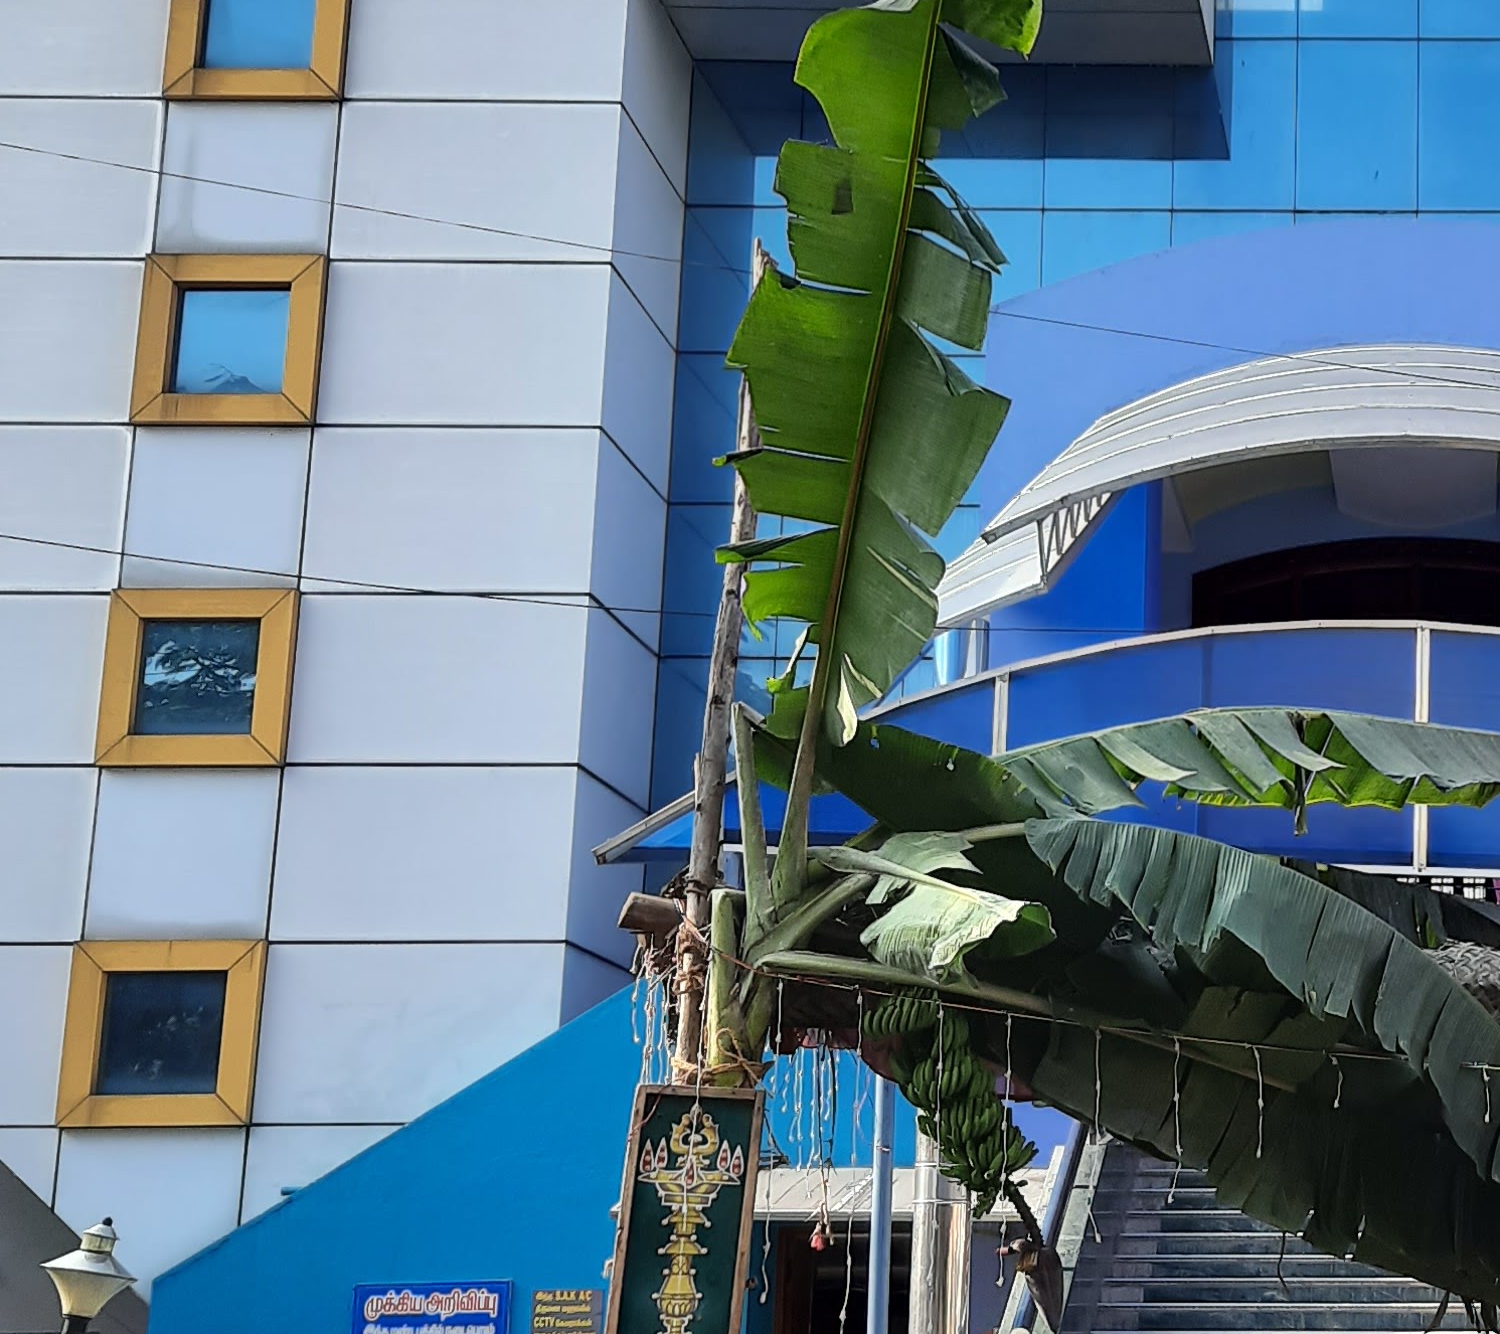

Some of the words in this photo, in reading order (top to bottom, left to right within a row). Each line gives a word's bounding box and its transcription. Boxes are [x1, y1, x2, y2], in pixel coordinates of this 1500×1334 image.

[364, 1288, 424, 1320] முக்கிய
[425, 1287, 499, 1321] அறிவிப்பு
[533, 1316, 555, 1328] CCTV
